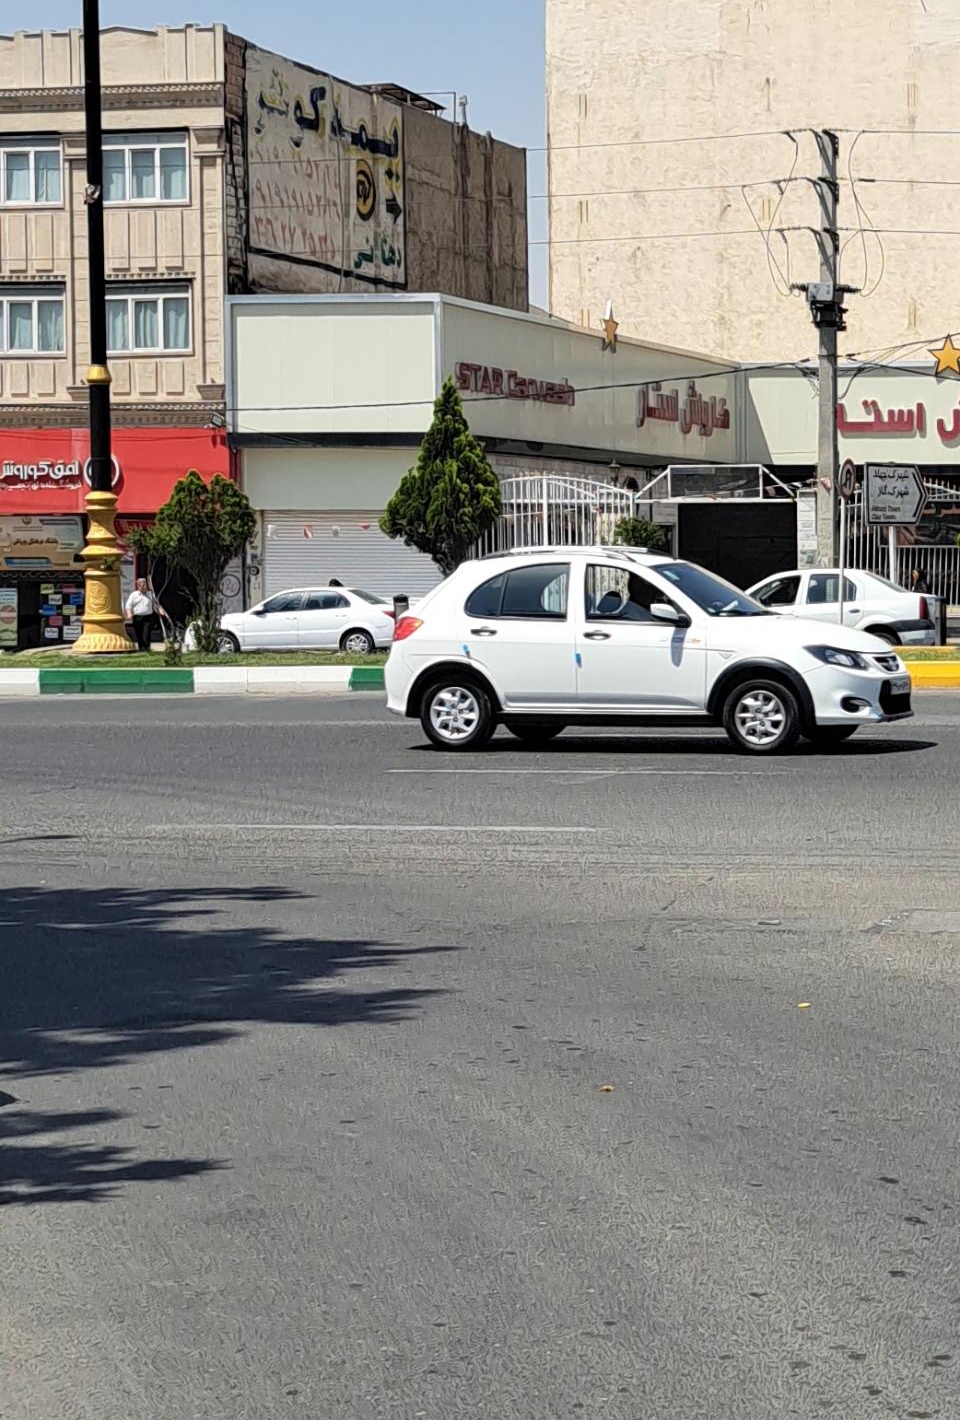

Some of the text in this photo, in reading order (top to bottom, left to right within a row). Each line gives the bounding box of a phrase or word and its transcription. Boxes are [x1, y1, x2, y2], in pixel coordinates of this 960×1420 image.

[457, 362, 503, 395] STAR
[636, 379, 730, 437] کارواش استار
[837, 399, 925, 434] استا
[0, 459, 79, 480] افق کوروش
[887, 469, 909, 482] شهرک
[888, 484, 909, 499] شهرک
